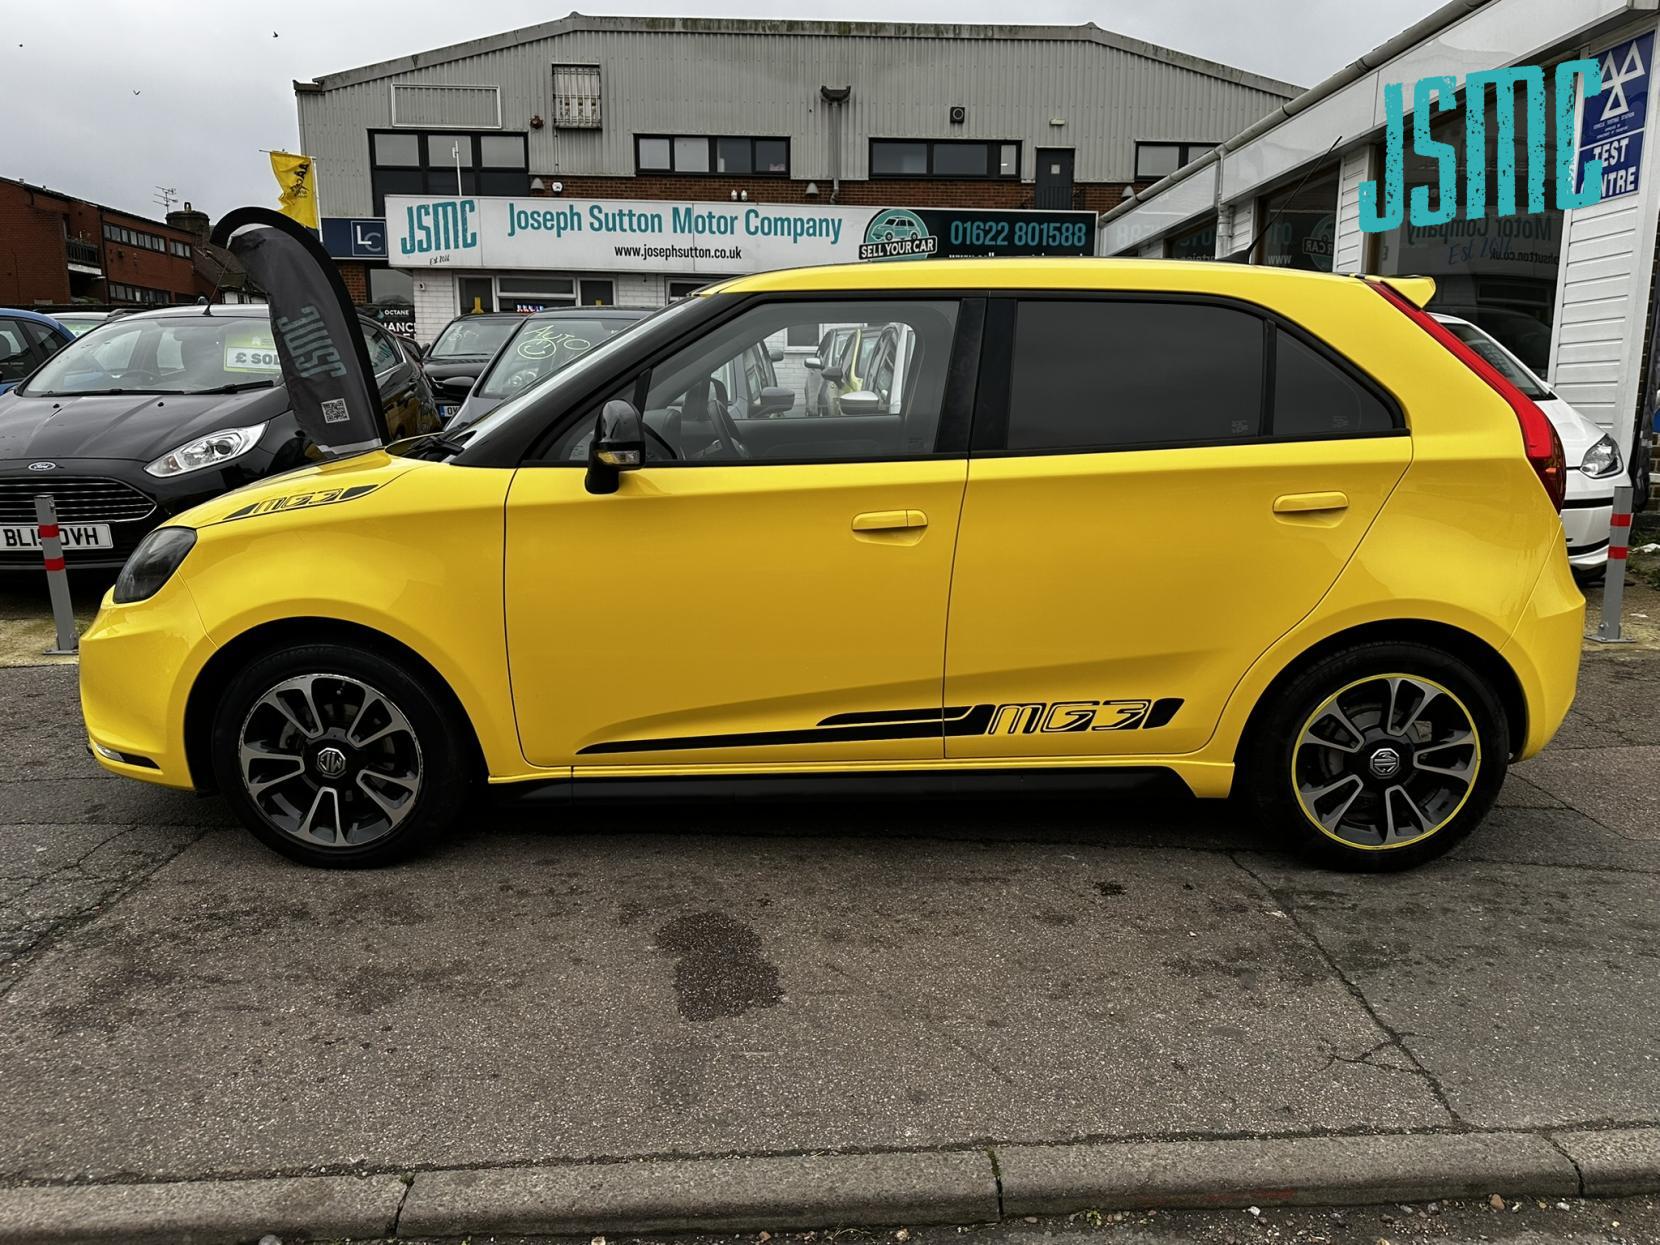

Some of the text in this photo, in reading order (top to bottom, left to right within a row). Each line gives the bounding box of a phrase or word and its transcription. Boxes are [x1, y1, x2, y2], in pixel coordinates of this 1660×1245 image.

[1594, 138, 1629, 167] TEST
[1580, 166, 1636, 197] NTRE
[401, 200, 477, 255] JSMC
[508, 203, 843, 245] Joseph Sutton Motor Company
[950, 220, 1009, 246] 01622
[1014, 222, 1087, 247] 801588
[614, 244, 742, 261] www.josephsutton.co.uk
[861, 239, 934, 258] SELL YOUR CAR
[251, 353, 280, 365] SOL
[254, 488, 344, 513] MG3
[3, 528, 42, 547] BL1
[988, 700, 1151, 735] MG3
